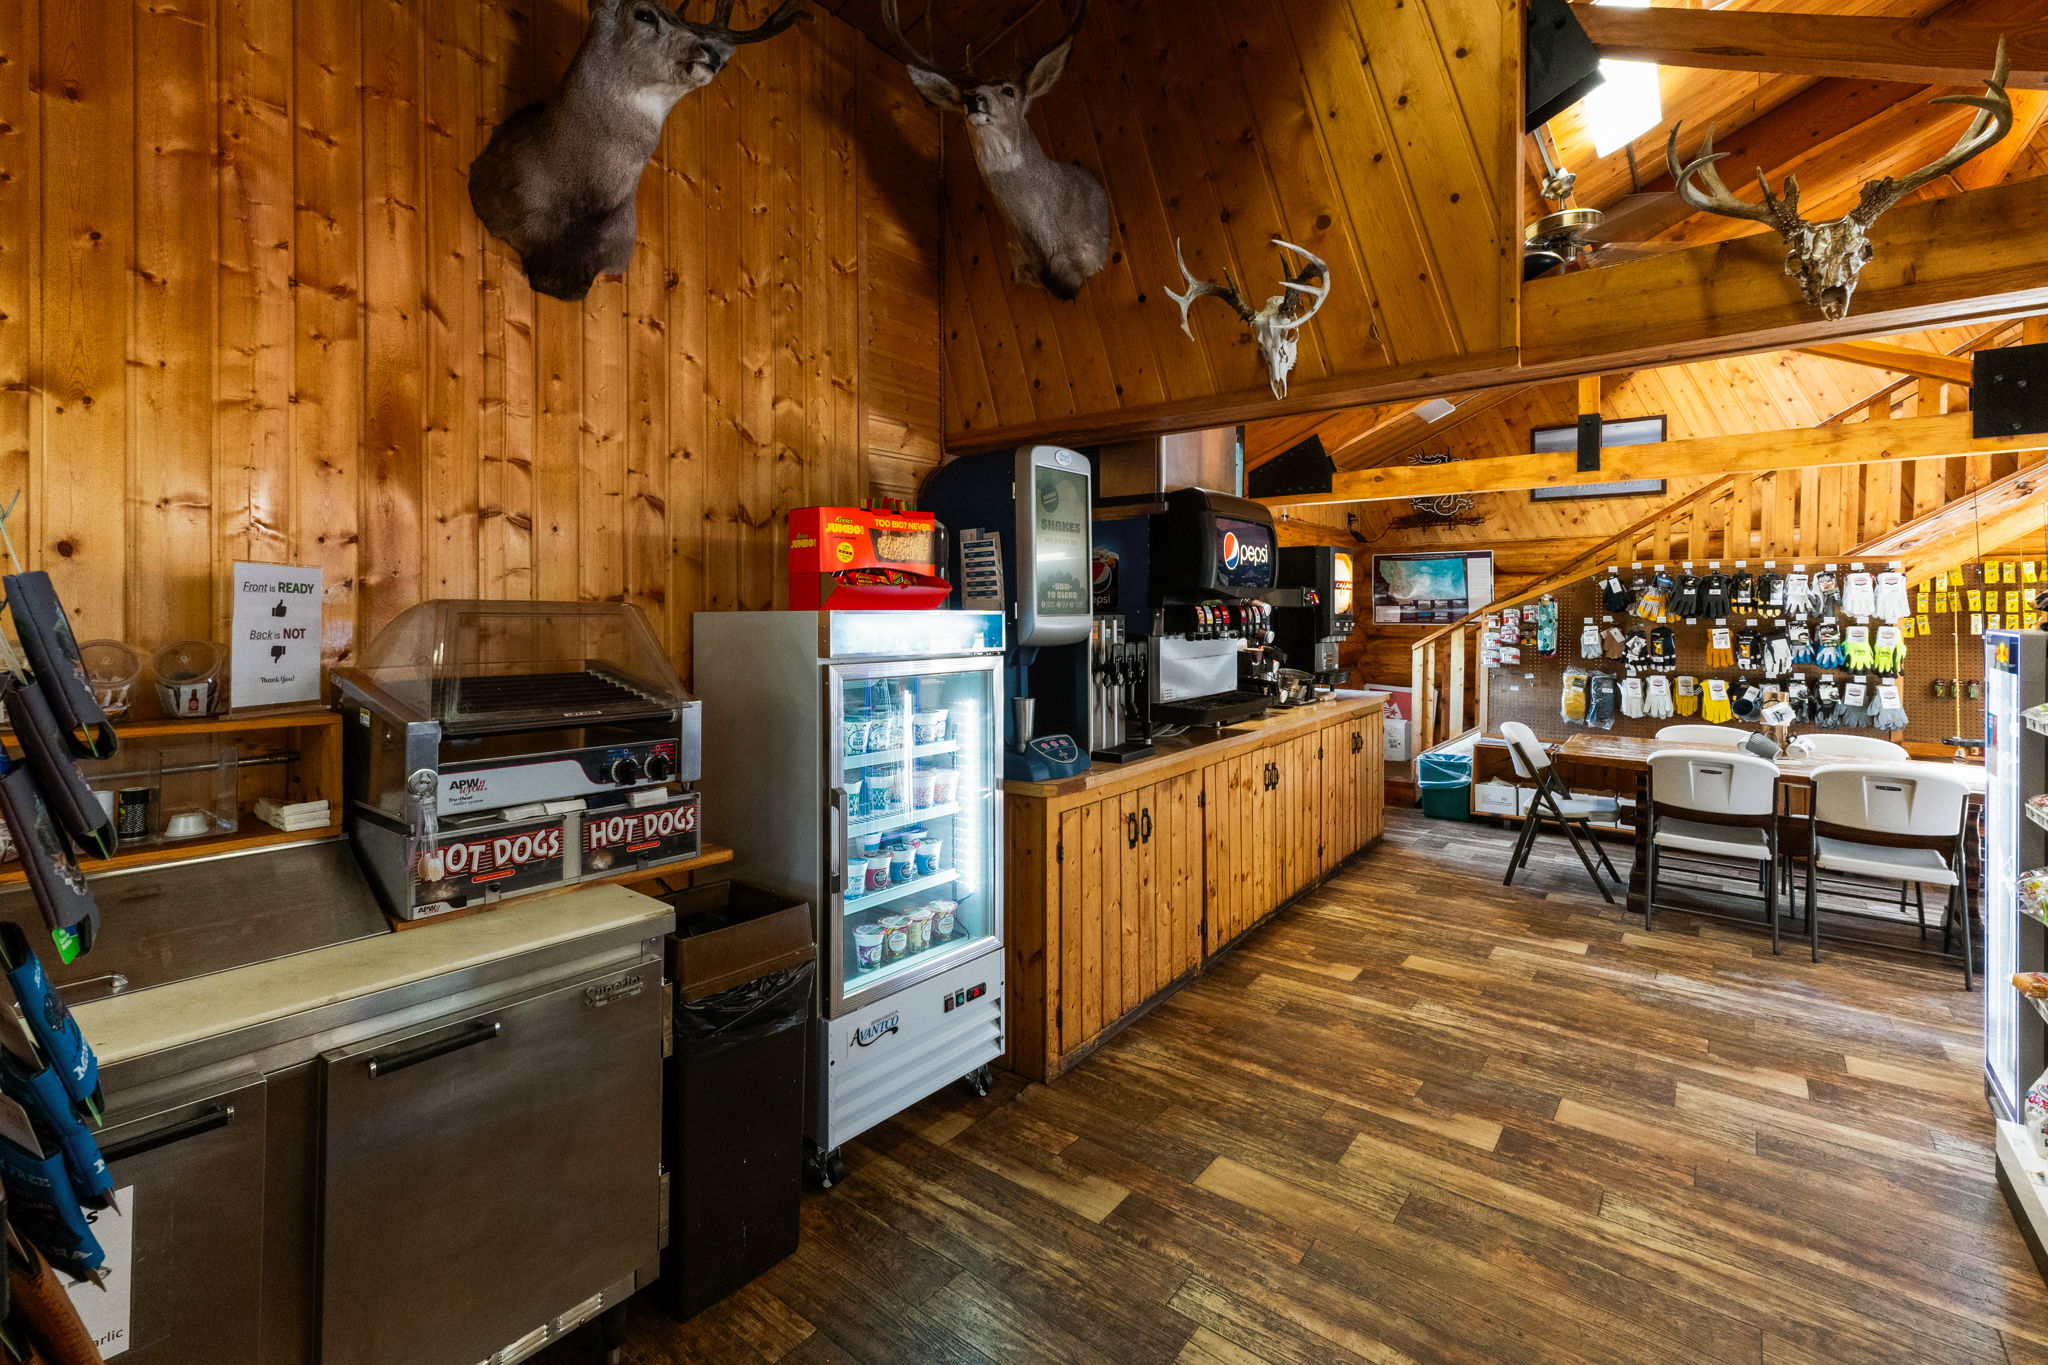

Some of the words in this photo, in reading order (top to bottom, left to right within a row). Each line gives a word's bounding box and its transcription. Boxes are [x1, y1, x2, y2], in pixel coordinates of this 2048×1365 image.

[875, 518, 891, 528] TOO
[892, 520, 907, 529] BIG?
[1040, 519, 1081, 534] SHAKES
[1240, 544, 1268, 566] pepsi
[243, 581, 268, 592] Front
[269, 584, 275, 592] is
[278, 581, 314, 594] READY
[249, 630, 273, 640] Back
[274, 632, 281, 640] is
[283, 628, 306, 640] NOT
[260, 676, 279, 684] Thank
[280, 674, 295, 685] You!
[449, 778, 479, 790] APW
[591, 816, 640, 849] HOT
[643, 806, 696, 840] DOGS
[493, 829, 560, 867] DOGS
[417, 904, 437, 914] APW
[849, 1014, 899, 1047] AVANTCO
